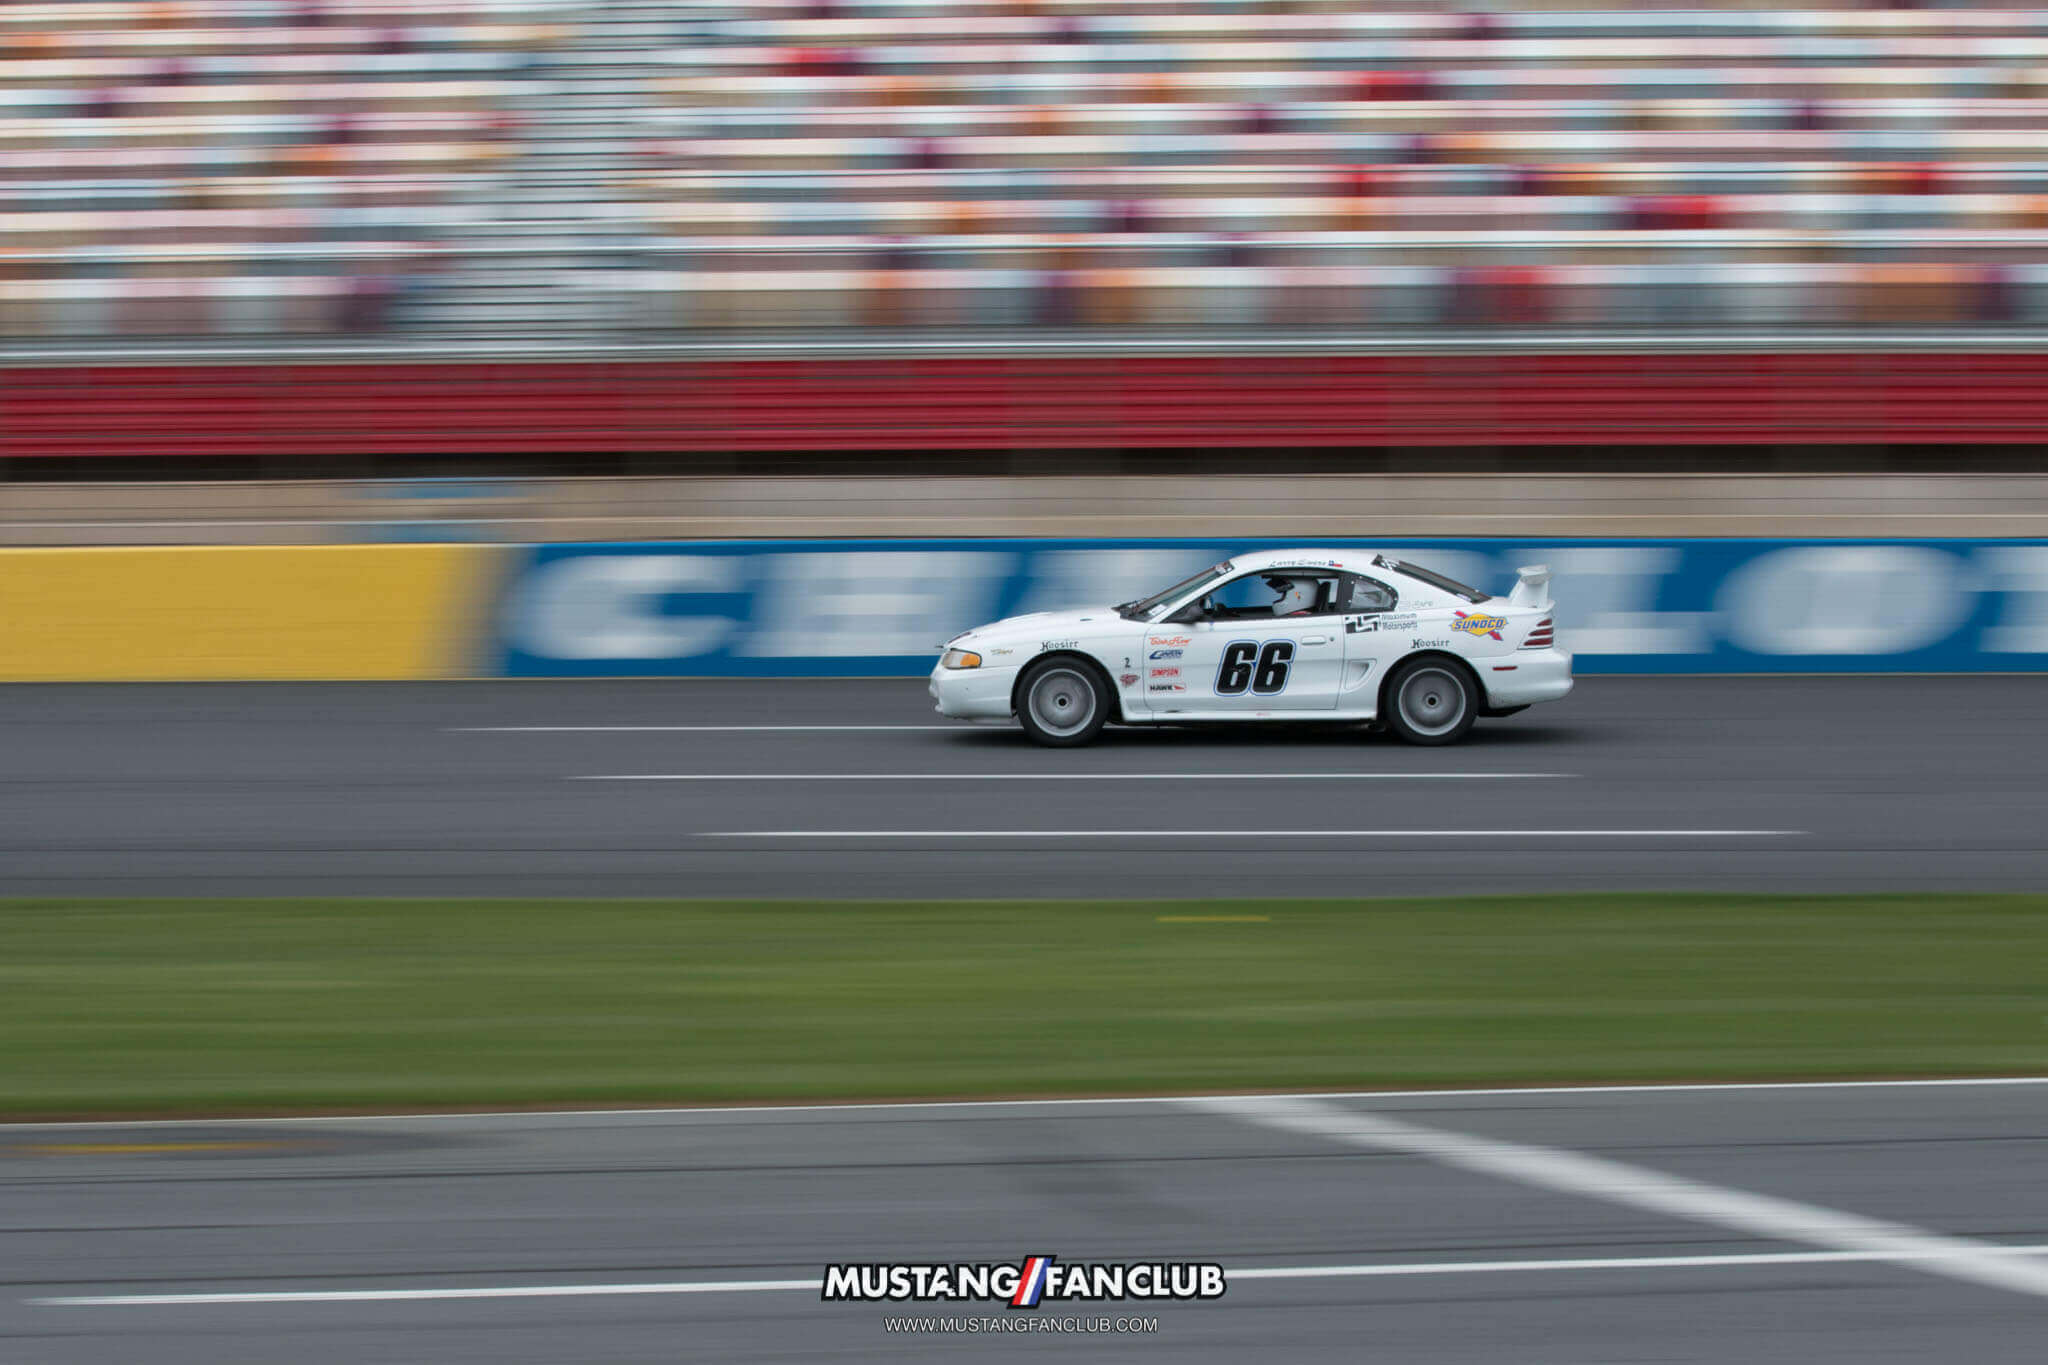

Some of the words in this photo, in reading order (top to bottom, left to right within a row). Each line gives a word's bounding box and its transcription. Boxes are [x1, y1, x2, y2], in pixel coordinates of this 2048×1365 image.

[1453, 618, 1506, 630] SUNOCO
[1041, 641, 1079, 651] Hoosier
[1411, 639, 1450, 648] Hoosier
[1151, 668, 1179, 677] SIMPSON
[1214, 639, 1297, 696] 66
